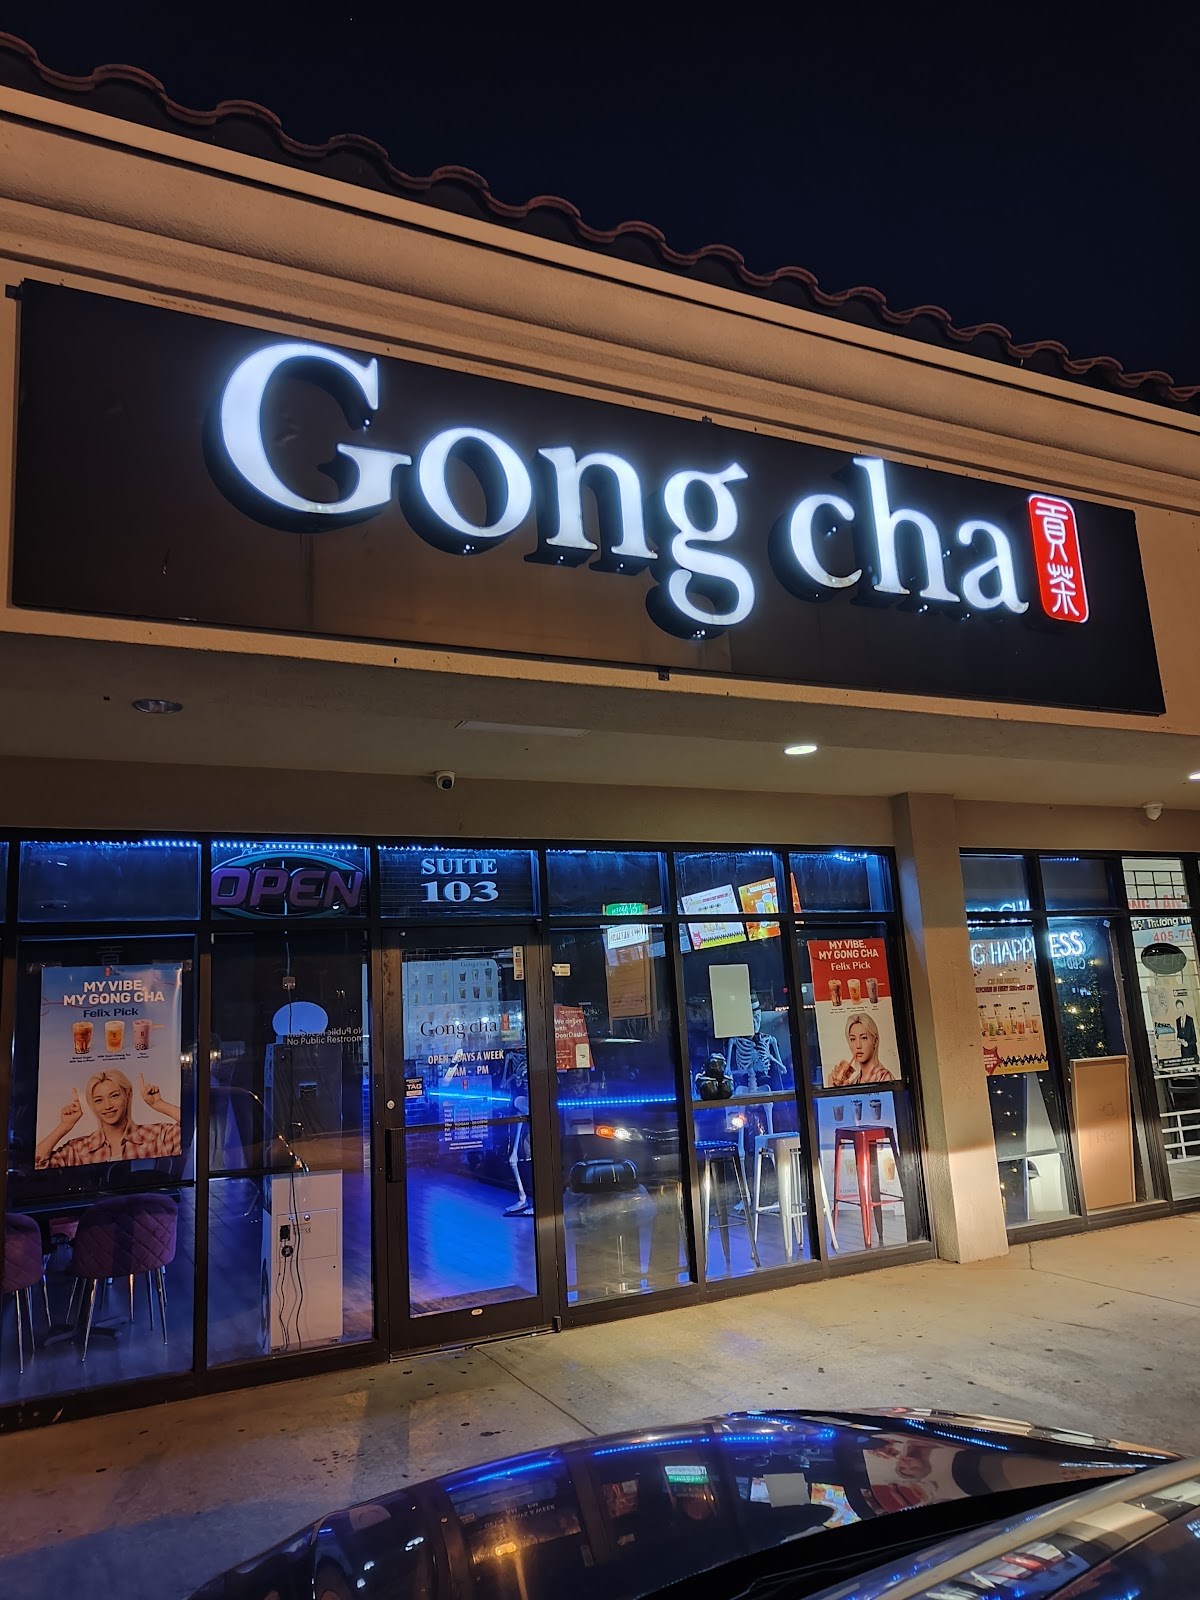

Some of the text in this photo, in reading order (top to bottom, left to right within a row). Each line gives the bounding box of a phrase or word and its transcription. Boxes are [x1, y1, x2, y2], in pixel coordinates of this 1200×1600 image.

[220, 343, 1029, 625] Gong cha
[1034, 499, 1080, 618] 貢茶
[421, 858, 498, 875] SUITE
[211, 867, 364, 908] OPEN
[421, 881, 499, 902] 103
[829, 939, 867, 950] MY VIBE,
[818, 948, 879, 960] MY GONG CHA
[831, 960, 871, 971] Felix Pick
[84, 980, 107, 993] MY
[63, 991, 165, 1006] MY GONG CHA
[83, 1007, 139, 1018] Felix Pick
[420, 1021, 466, 1039] Gong
[469, 1017, 498, 1033] cha
[300, 1037, 324, 1045] Public
[427, 1054, 449, 1065] OPEN
[458, 1052, 476, 1063] DAYS
[476, 1051, 482, 1061] A
[483, 1049, 505, 1061] WEEK
[477, 1065, 489, 1074] PM
